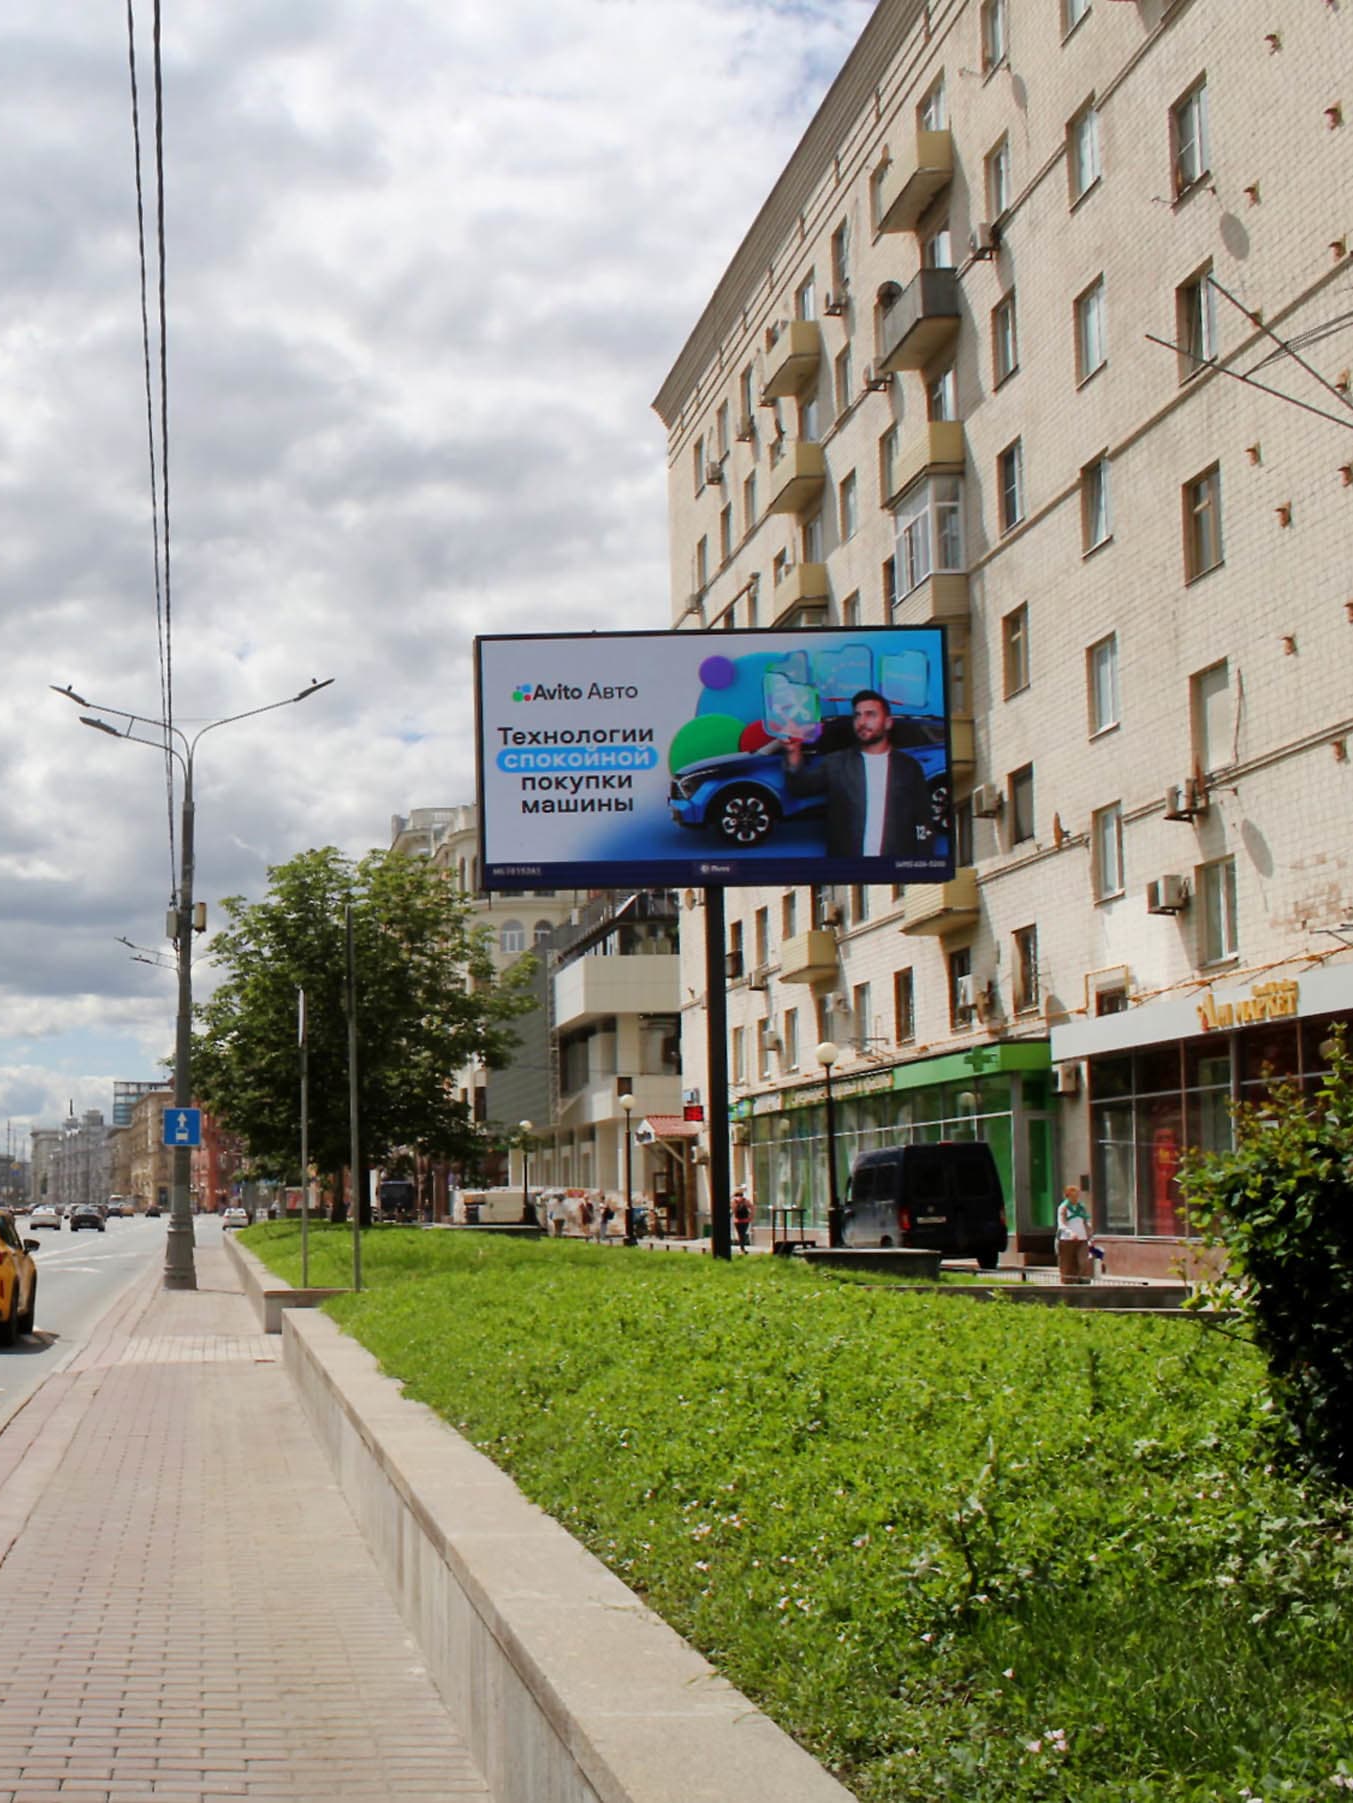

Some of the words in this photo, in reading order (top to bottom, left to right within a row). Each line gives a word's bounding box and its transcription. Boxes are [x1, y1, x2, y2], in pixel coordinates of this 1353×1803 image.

[533, 683, 583, 701] Avito
[587, 682, 639, 700] Авто
[497, 726, 654, 746] Технологии
[503, 745, 649, 768] спокойной
[521, 774, 633, 795] покупки
[521, 798, 634, 814] машины
